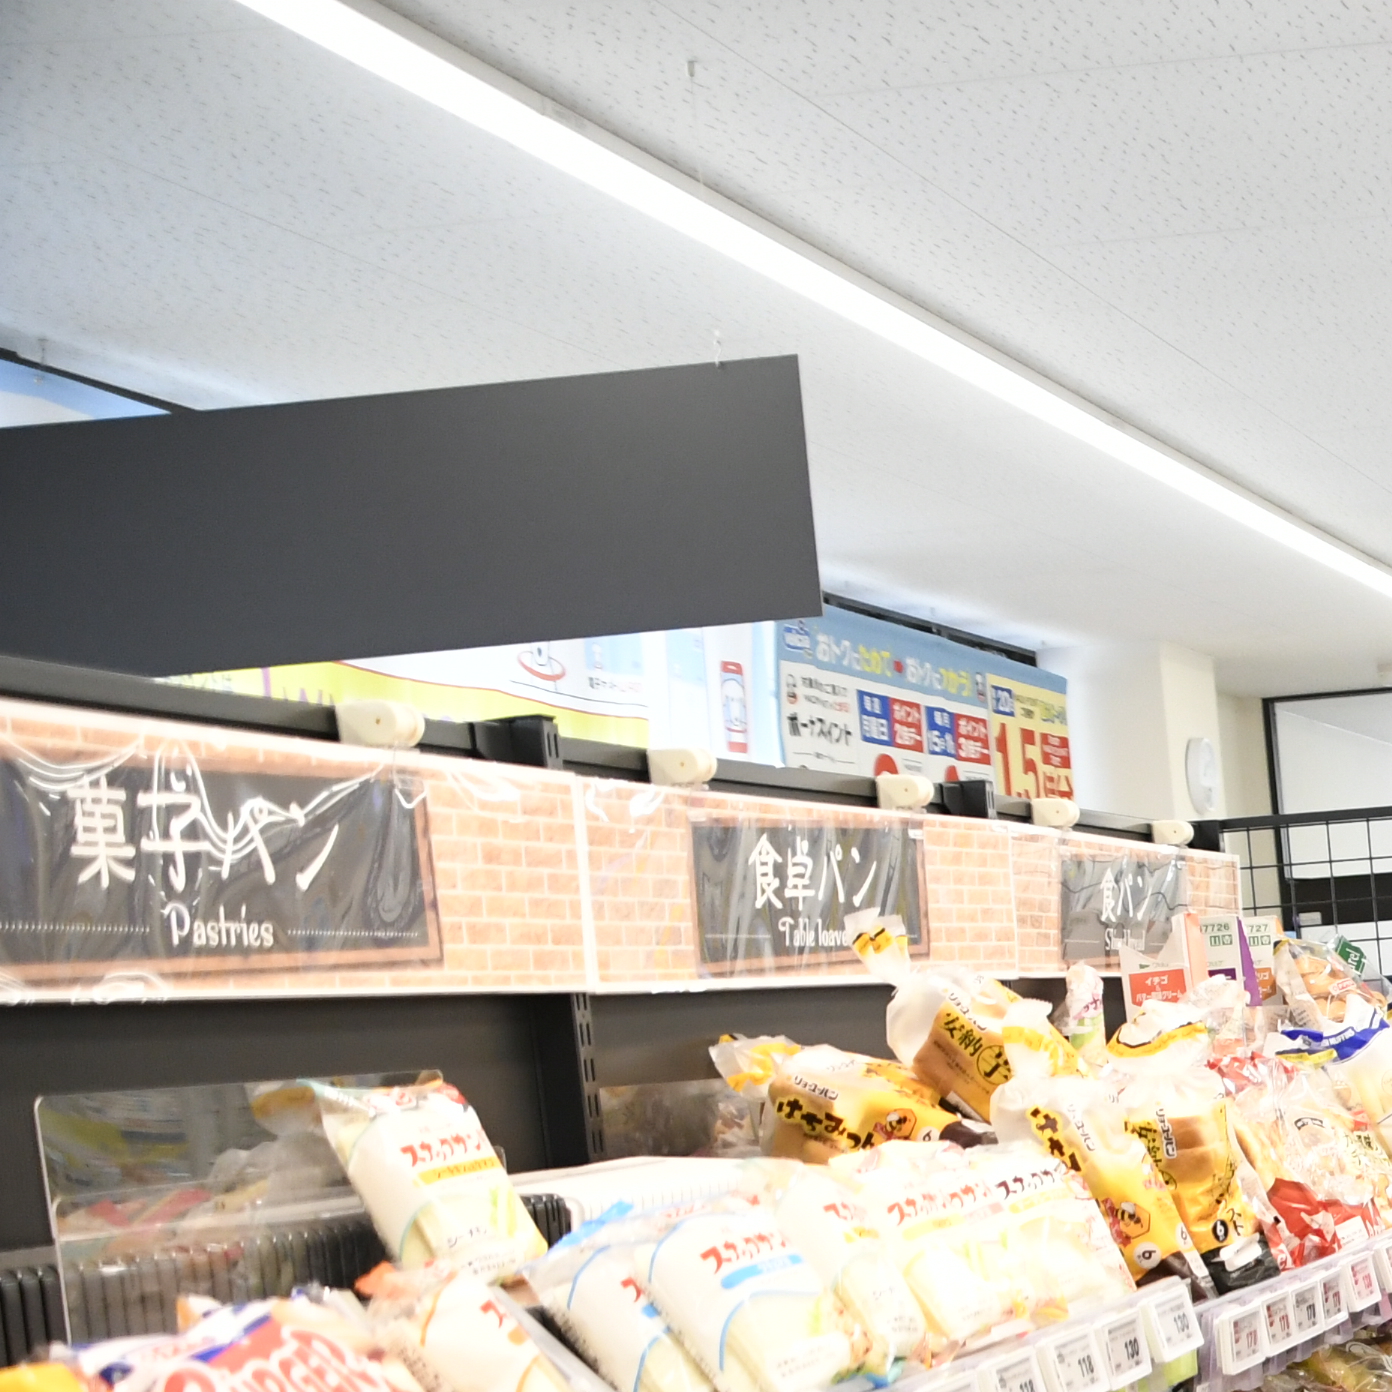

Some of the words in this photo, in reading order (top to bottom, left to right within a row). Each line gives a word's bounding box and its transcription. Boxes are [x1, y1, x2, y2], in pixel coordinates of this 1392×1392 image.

[66, 770, 340, 892] 菓子パン
[748, 832, 877, 911] 食卓パン
[1099, 867, 1152, 923] 食パン
[161, 903, 274, 948] Pastries
[778, 916, 815, 947] Table
